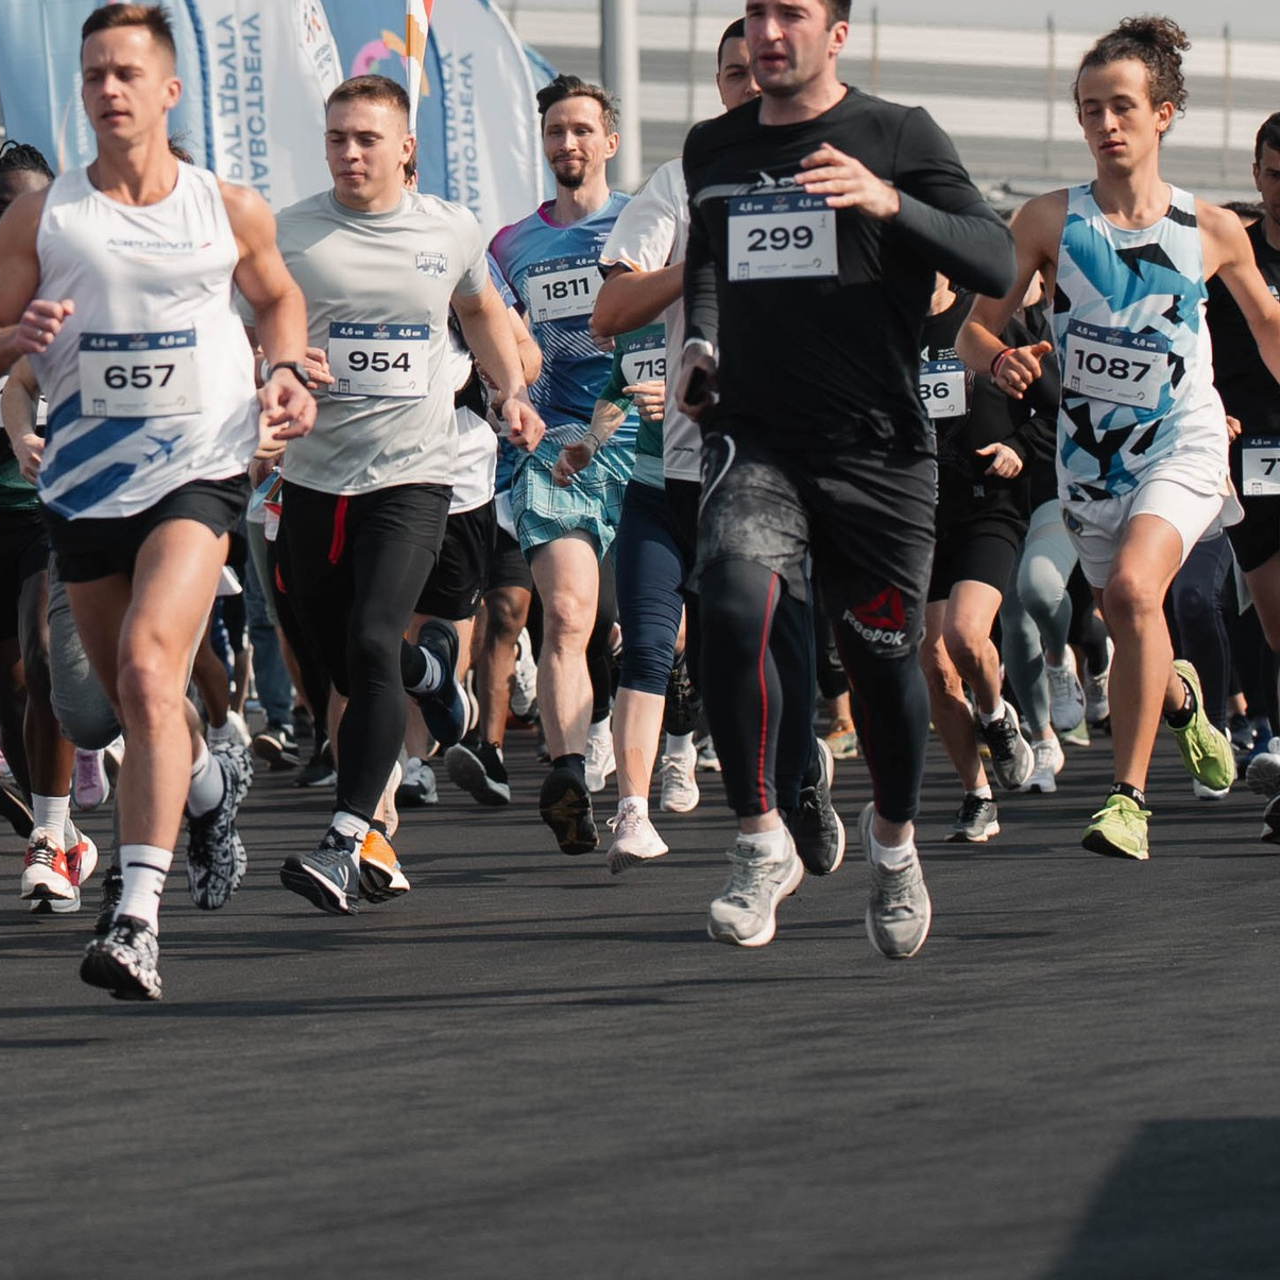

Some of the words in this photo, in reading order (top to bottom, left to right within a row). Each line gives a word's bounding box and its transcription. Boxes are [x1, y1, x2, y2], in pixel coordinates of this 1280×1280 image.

[747, 225, 814, 252] 299
[542, 277, 590, 301] 1811
[348, 350, 411, 372] 954
[634, 358, 666, 380] 713
[1074, 349, 1151, 383] 1087
[104, 364, 176, 389] 657
[842, 609, 907, 646] Reebok
